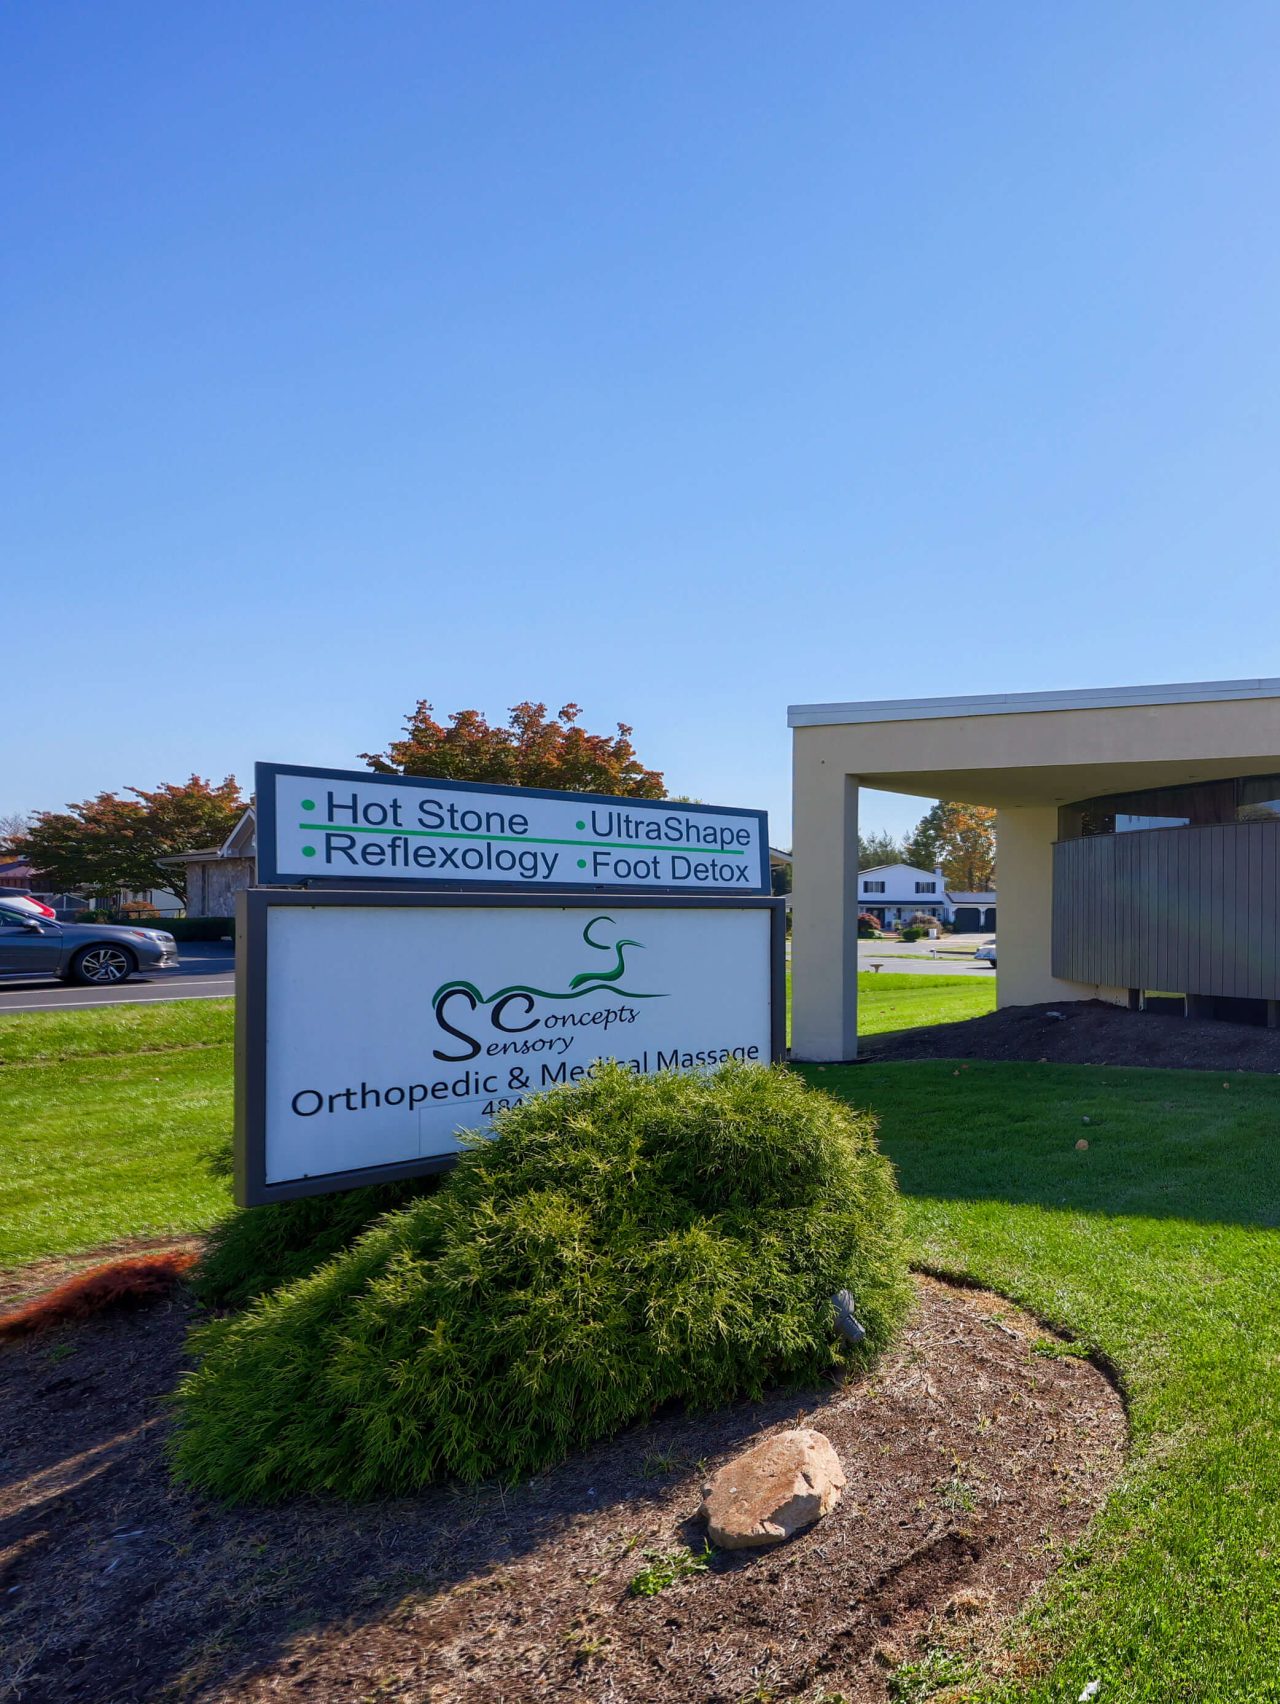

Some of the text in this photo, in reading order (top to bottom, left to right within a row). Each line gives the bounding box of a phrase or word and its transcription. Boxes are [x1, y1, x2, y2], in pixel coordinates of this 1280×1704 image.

[327, 791, 529, 835] Hot Stone
[591, 810, 751, 850] UltraShape
[325, 832, 559, 880] Reflexology
[592, 851, 750, 882] Foot Detox
[432, 988, 574, 1063] Sensory
[490, 992, 641, 1033] Concepts
[291, 1070, 499, 1117] Orthopedic
[507, 1066, 530, 1090] &
